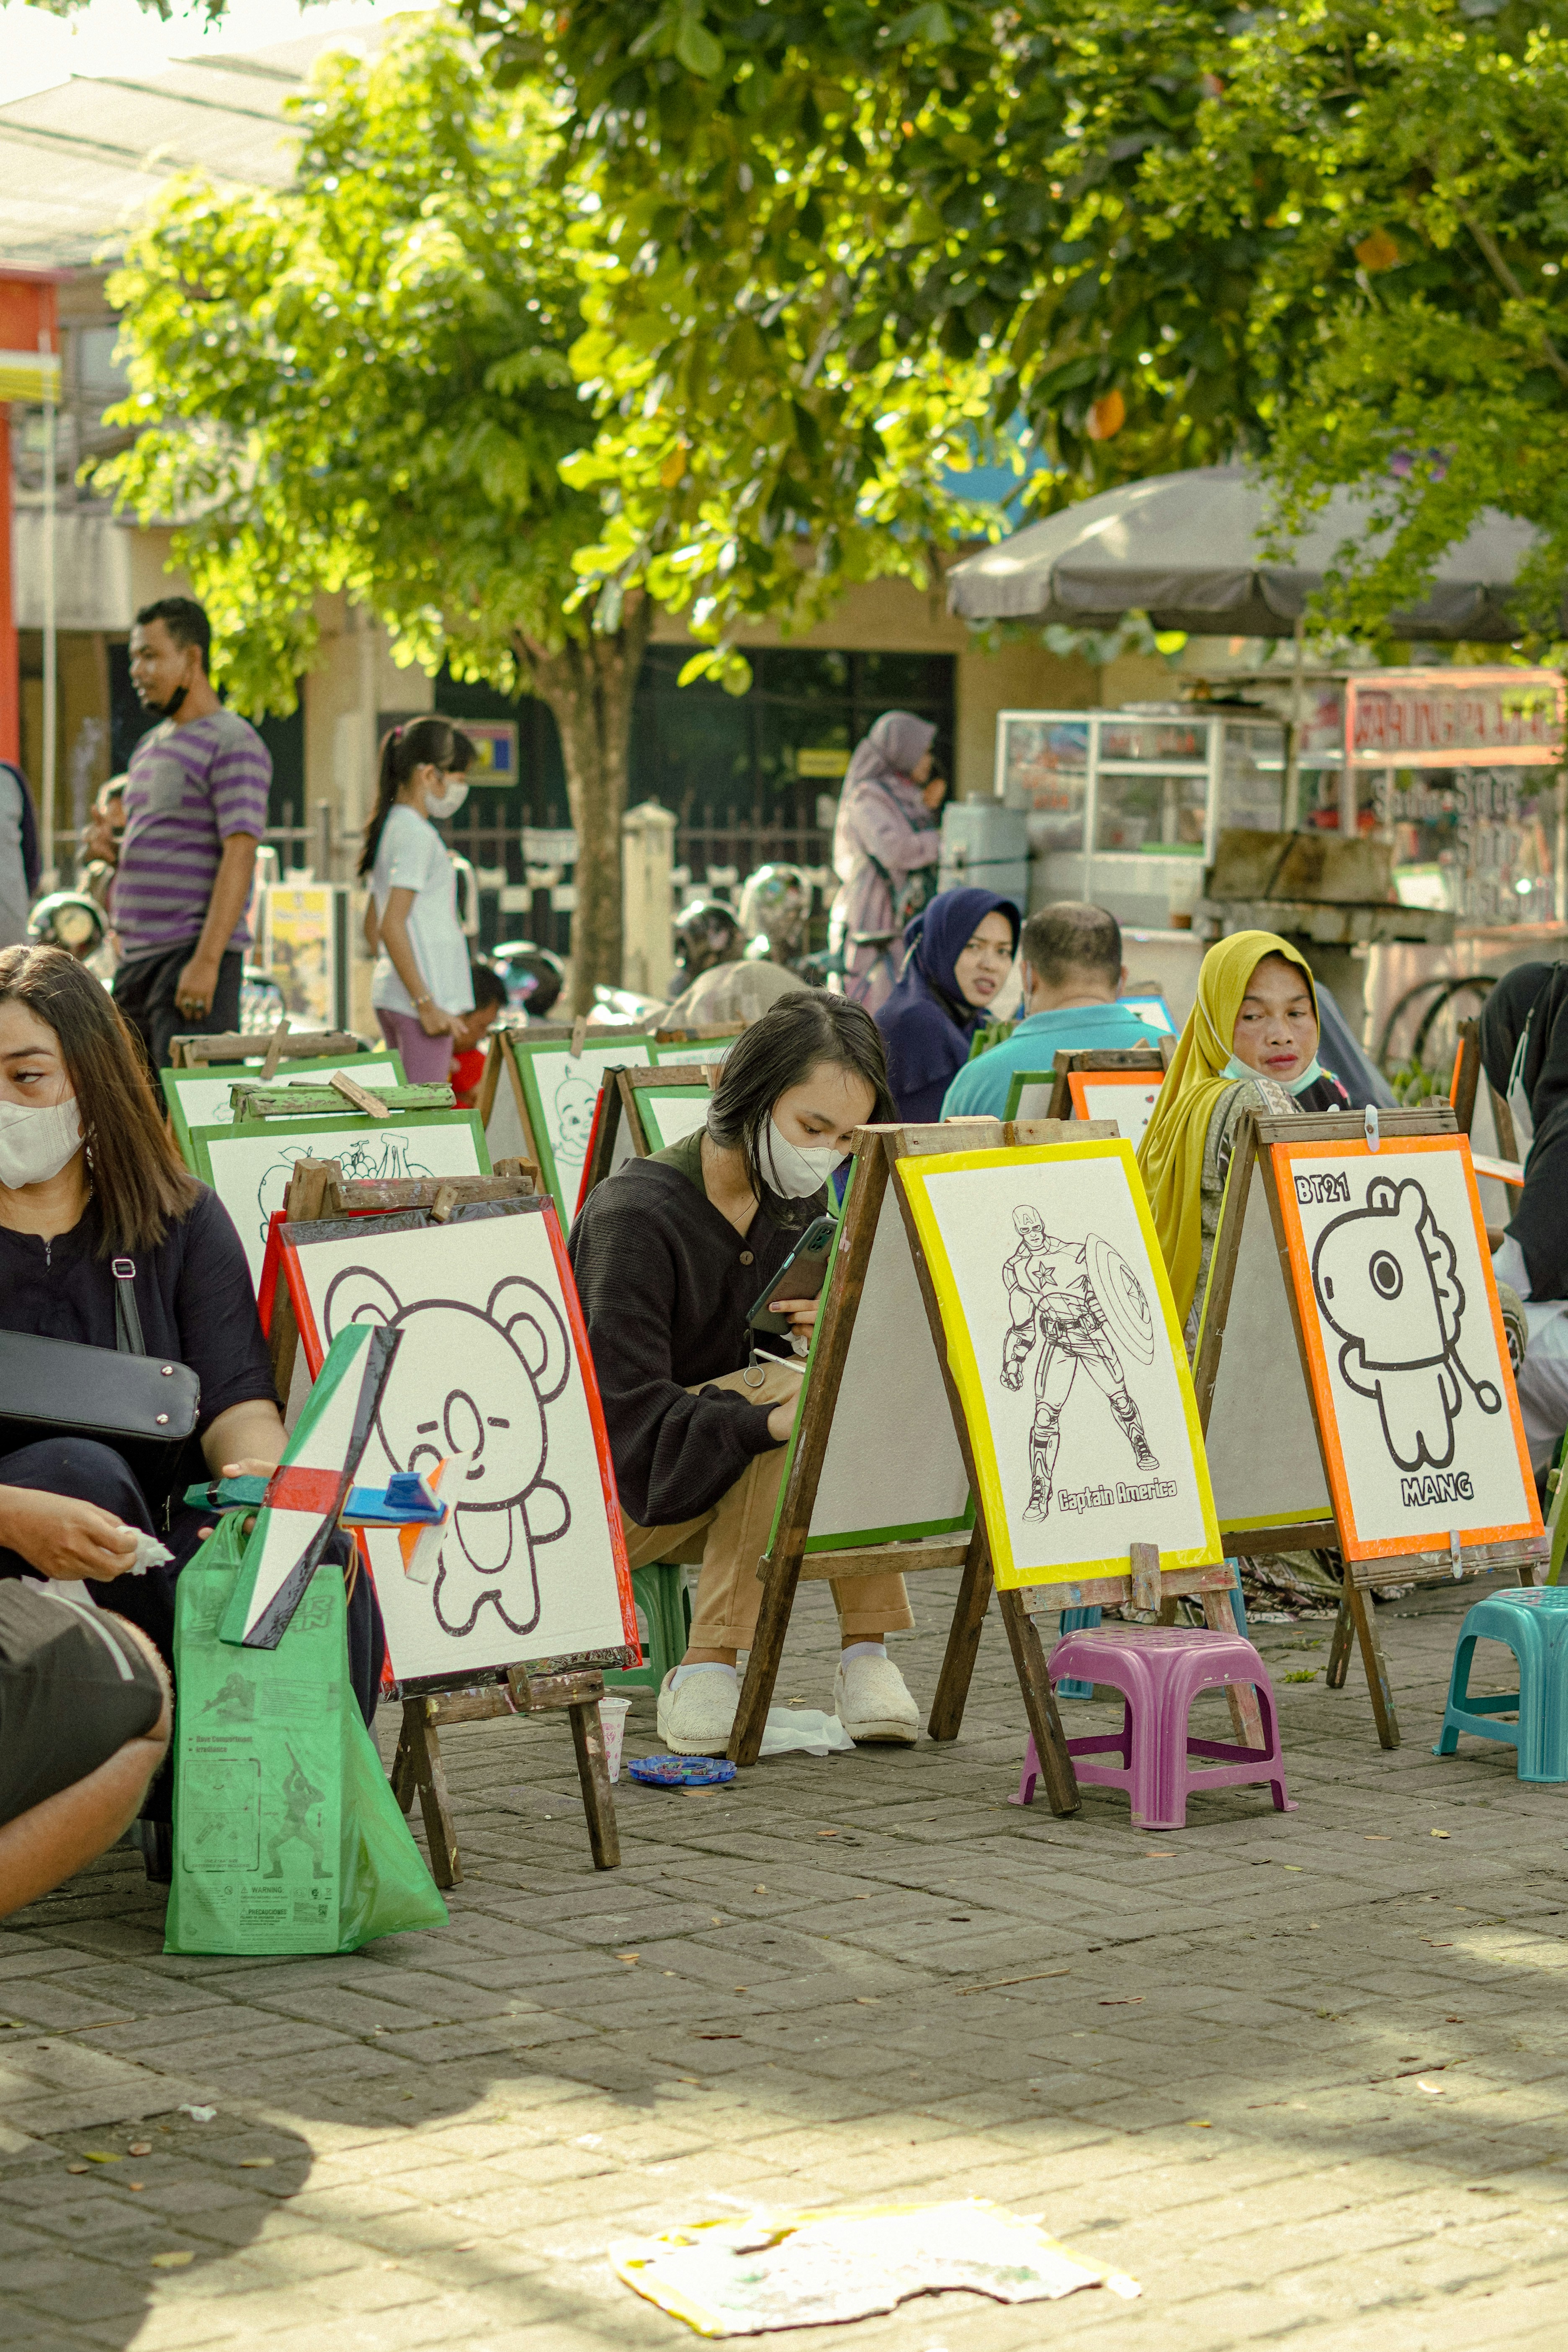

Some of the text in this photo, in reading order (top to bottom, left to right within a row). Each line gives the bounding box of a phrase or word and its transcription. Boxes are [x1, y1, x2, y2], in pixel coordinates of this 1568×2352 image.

[1294, 1171, 1350, 1204] BT21
[1023, 1214, 1034, 1225] A
[1058, 1478, 1177, 1514] Captain America
[1401, 1471, 1474, 1506] MANG
